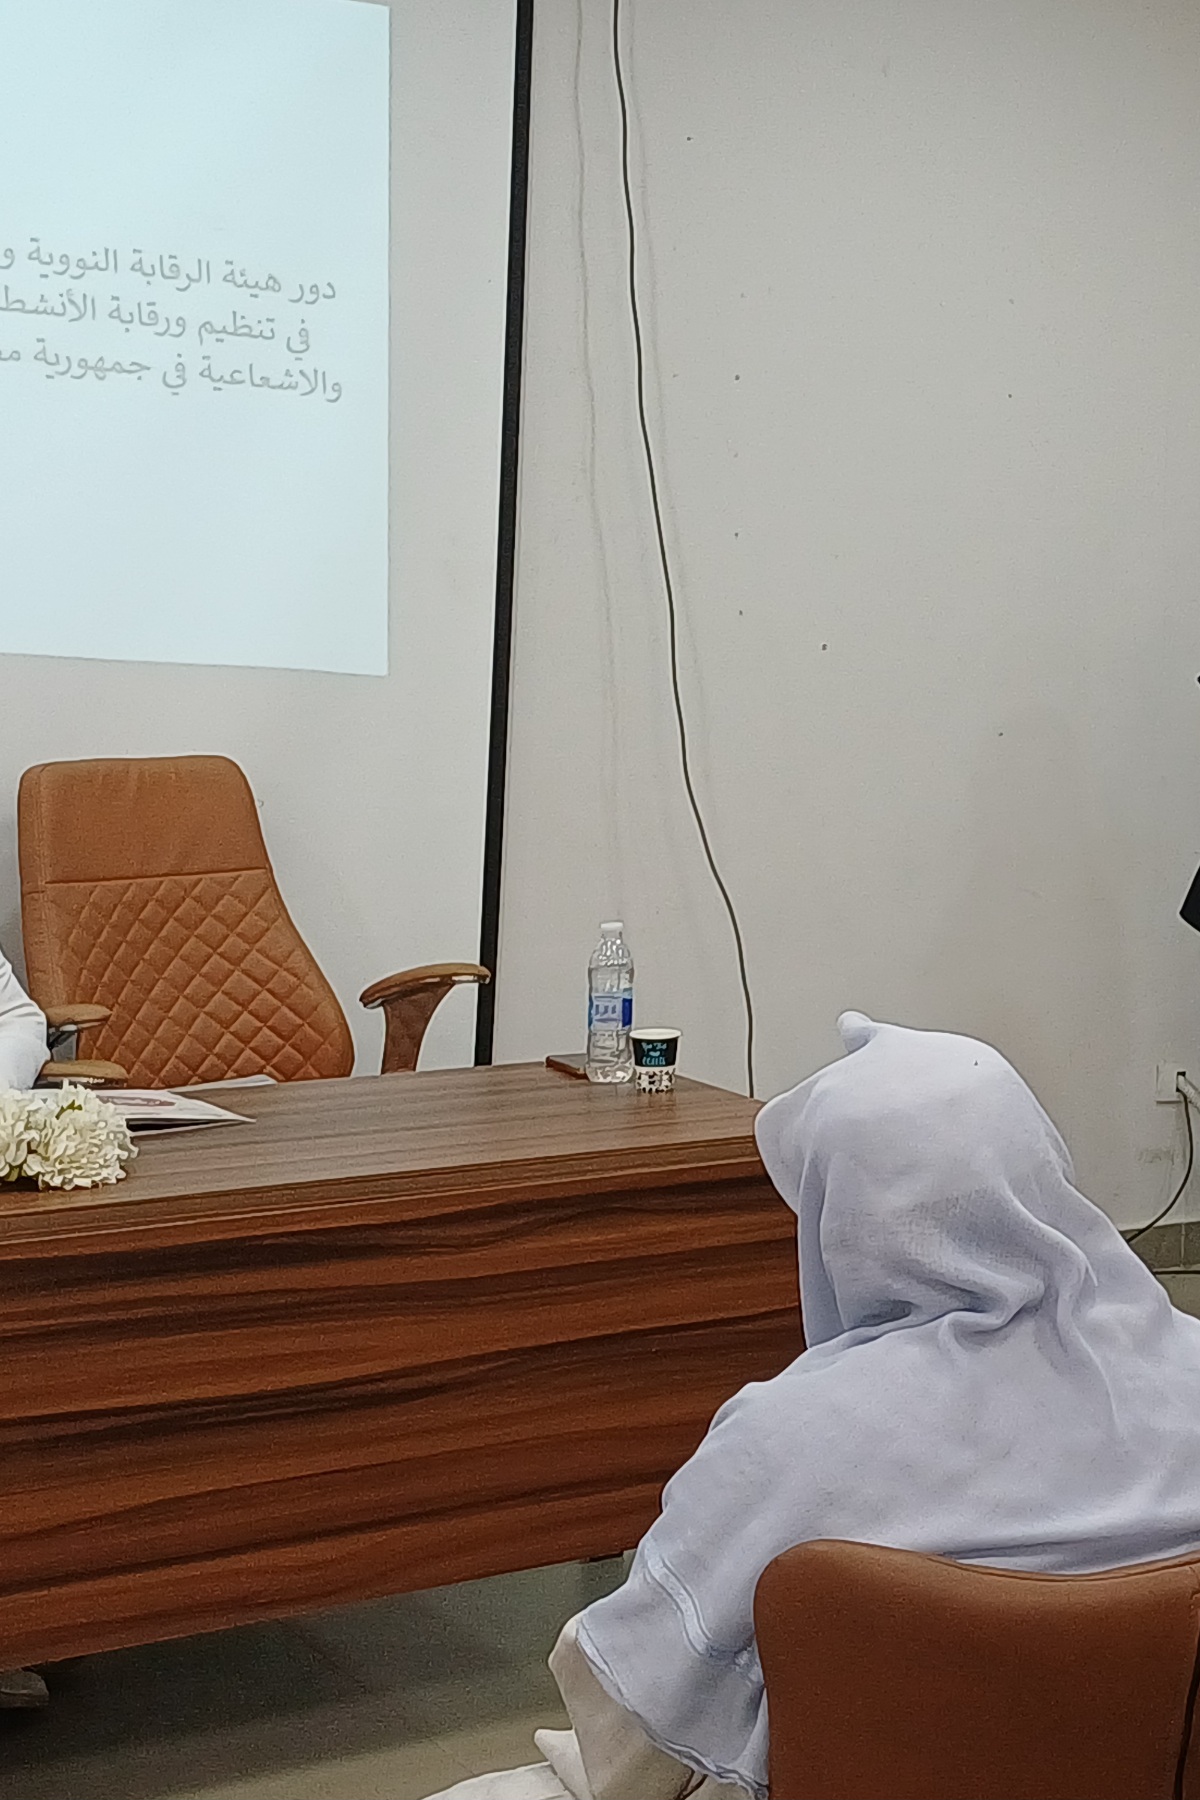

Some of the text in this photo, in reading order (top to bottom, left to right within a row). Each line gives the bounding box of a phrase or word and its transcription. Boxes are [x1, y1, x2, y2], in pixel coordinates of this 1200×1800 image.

[26, 237, 119, 281] النووية
[129, 247, 211, 293] الرقابة
[221, 259, 282, 299] هيئة
[287, 281, 337, 305] دور
[0, 284, 311, 361] في تنظيم ورقابة الأنشط
[33, 337, 153, 382] جمهورية
[161, 352, 188, 397] في
[199, 354, 343, 404] والاشعاعية
